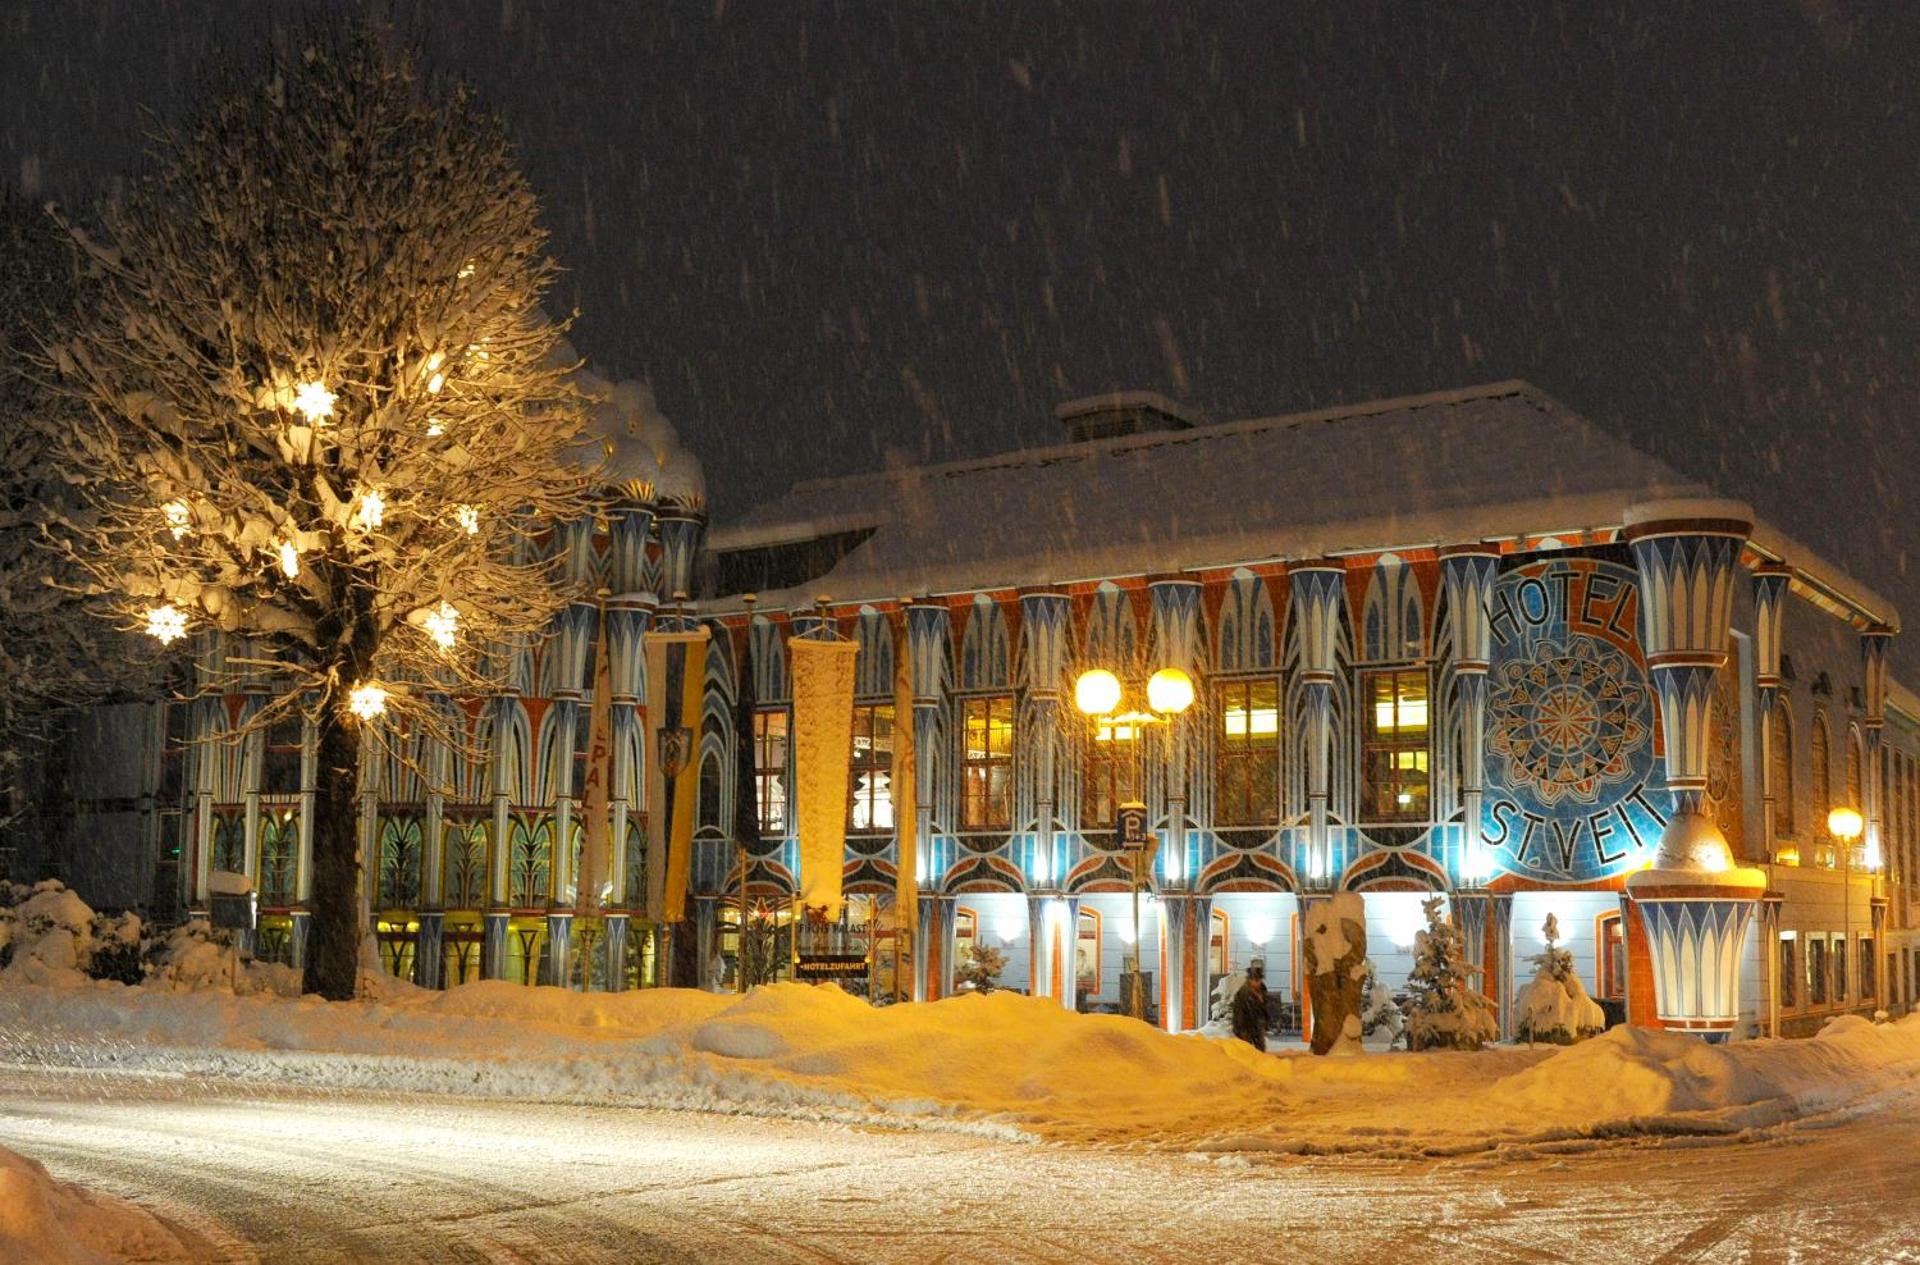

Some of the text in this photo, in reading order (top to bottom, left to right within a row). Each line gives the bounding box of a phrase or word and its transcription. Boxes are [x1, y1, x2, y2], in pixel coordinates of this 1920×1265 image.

[1482, 571, 1632, 646] HOTEL
[1552, 784, 1667, 870] VEIT
[803, 962, 865, 971] HOTELZUFAHRT
